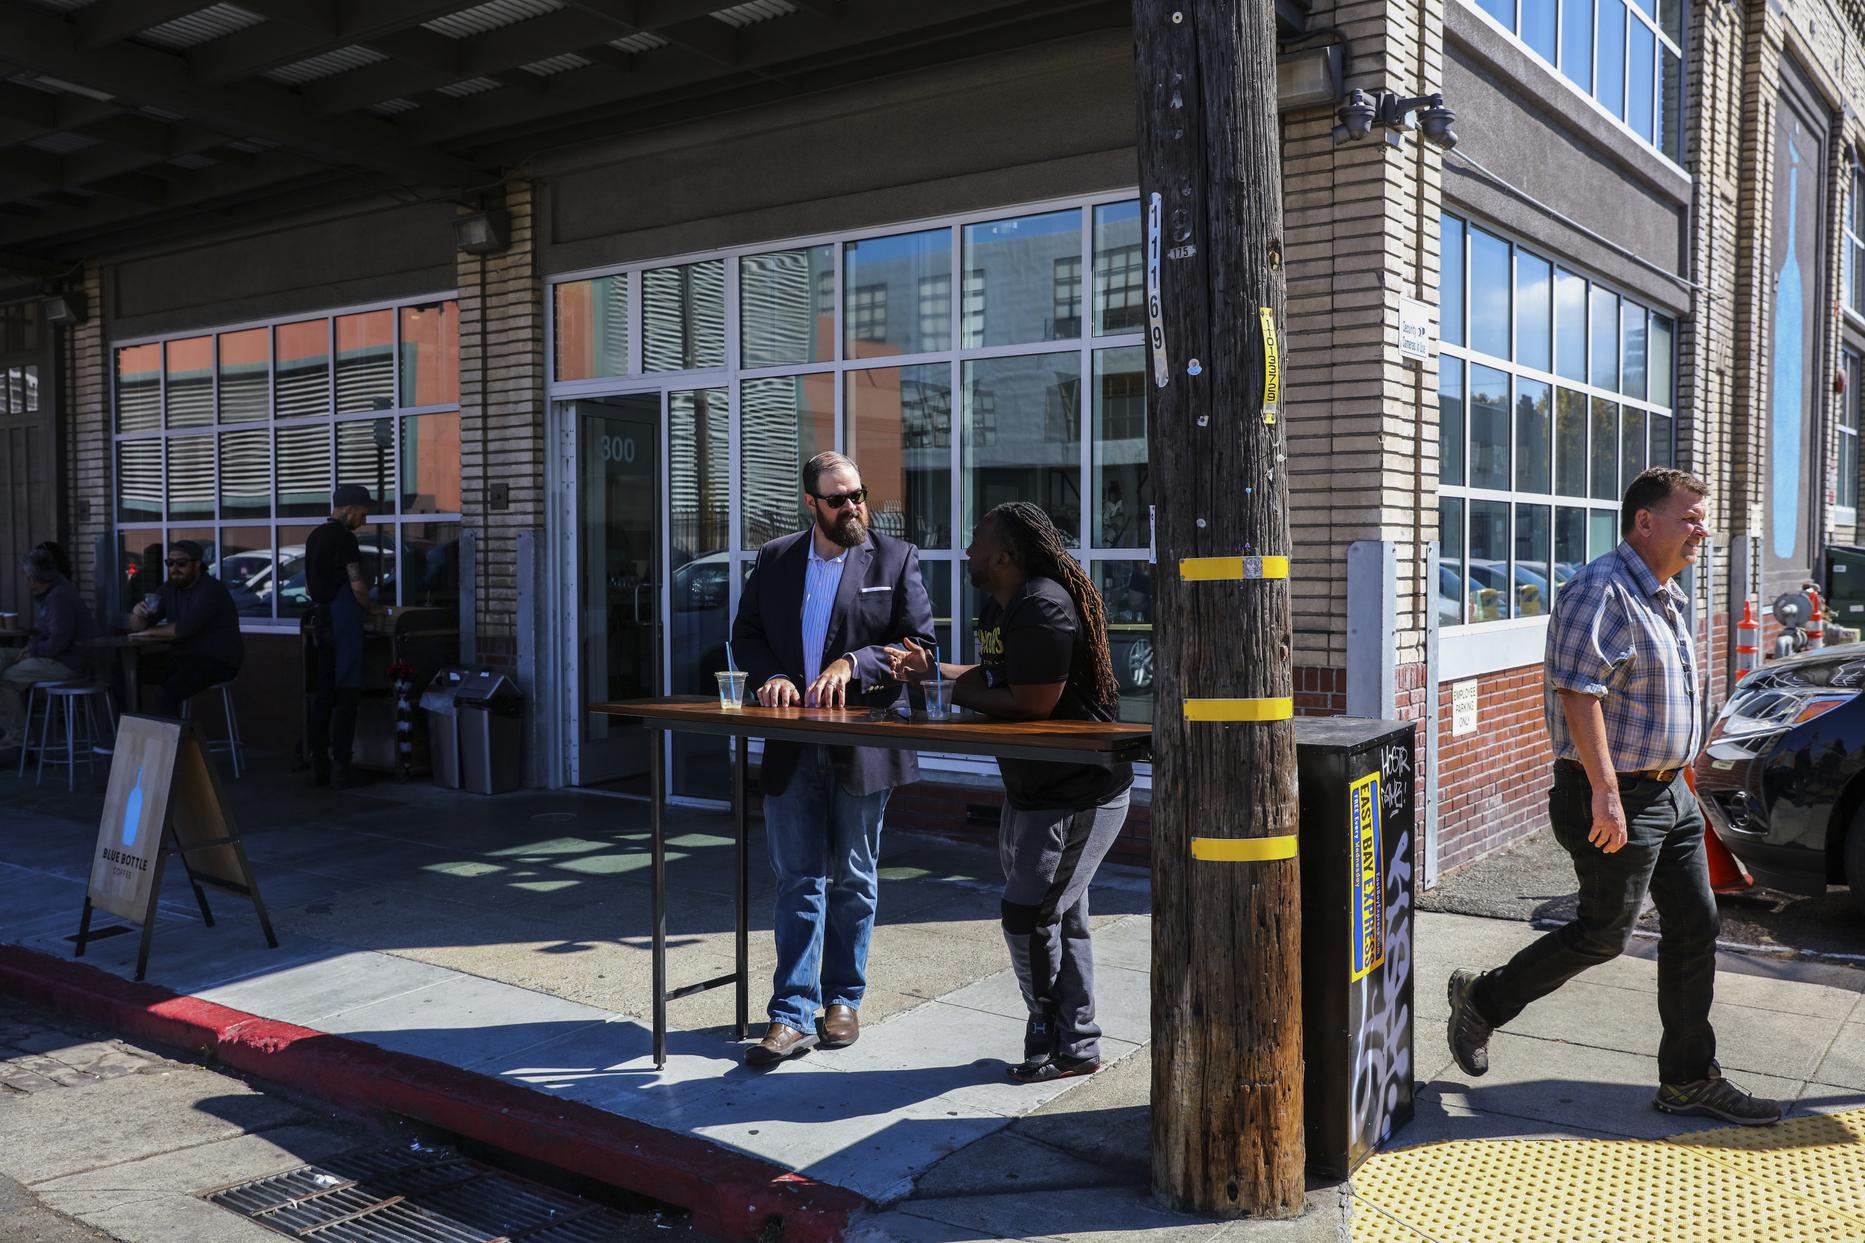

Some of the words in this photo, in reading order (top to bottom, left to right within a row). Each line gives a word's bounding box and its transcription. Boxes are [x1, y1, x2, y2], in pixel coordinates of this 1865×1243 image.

[1150, 205, 1163, 350] 11169
[1454, 686, 1476, 701] EMPLOYEE
[1456, 701, 1474, 712] PARKING
[1457, 716, 1470, 727] ONLY
[1361, 783, 1371, 830] EAST
[103, 848, 121, 863] BLUE
[121, 853, 148, 871] BOTTLE
[1362, 837, 1374, 872] BAY
[113, 866, 132, 880] COFFEE
[1363, 877, 1376, 967] EXPRESS
